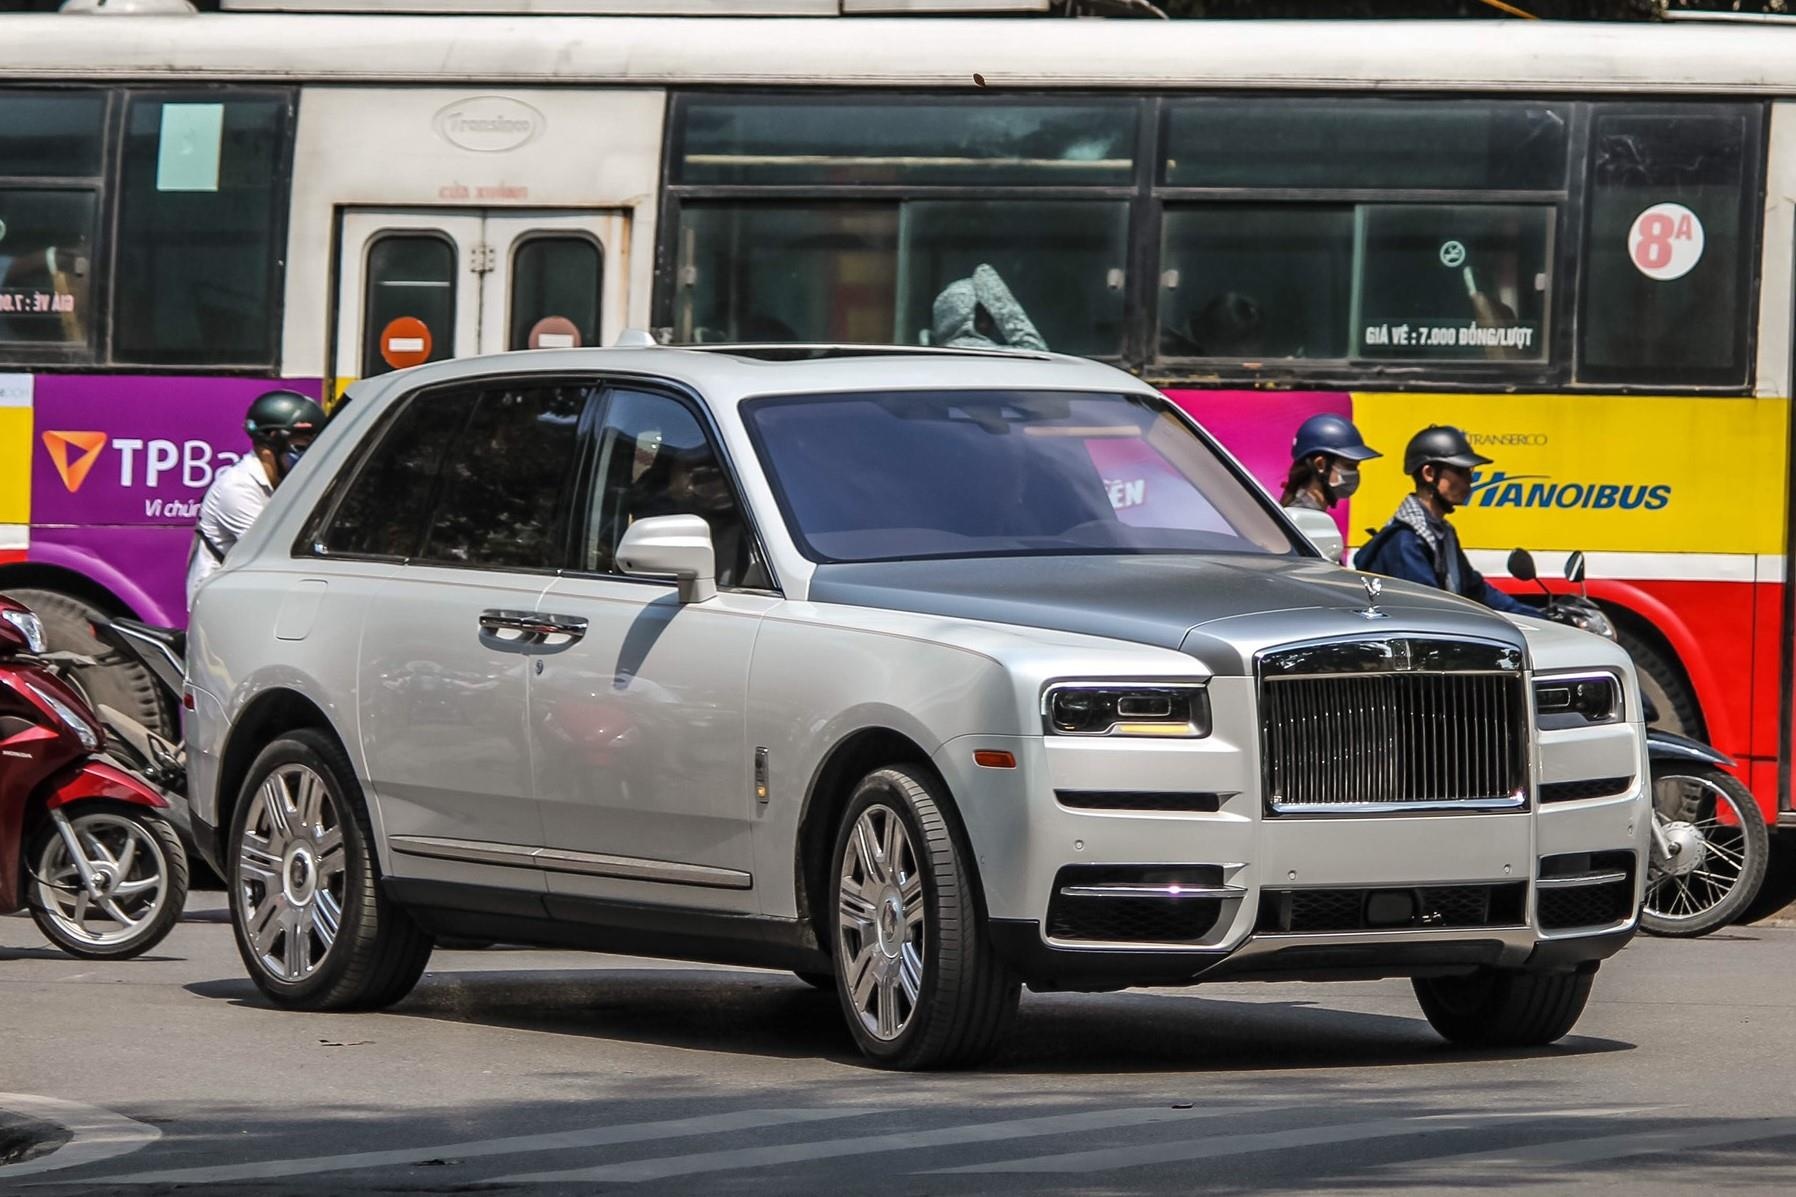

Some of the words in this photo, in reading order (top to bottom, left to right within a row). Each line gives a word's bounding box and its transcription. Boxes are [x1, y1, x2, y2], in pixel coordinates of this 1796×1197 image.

[1365, 324, 1389, 345] GIÁ
[1391, 324, 1409, 345] VÉ
[1419, 328, 1456, 345] 7.000
[1463, 471, 1671, 510] HANOIBUS
